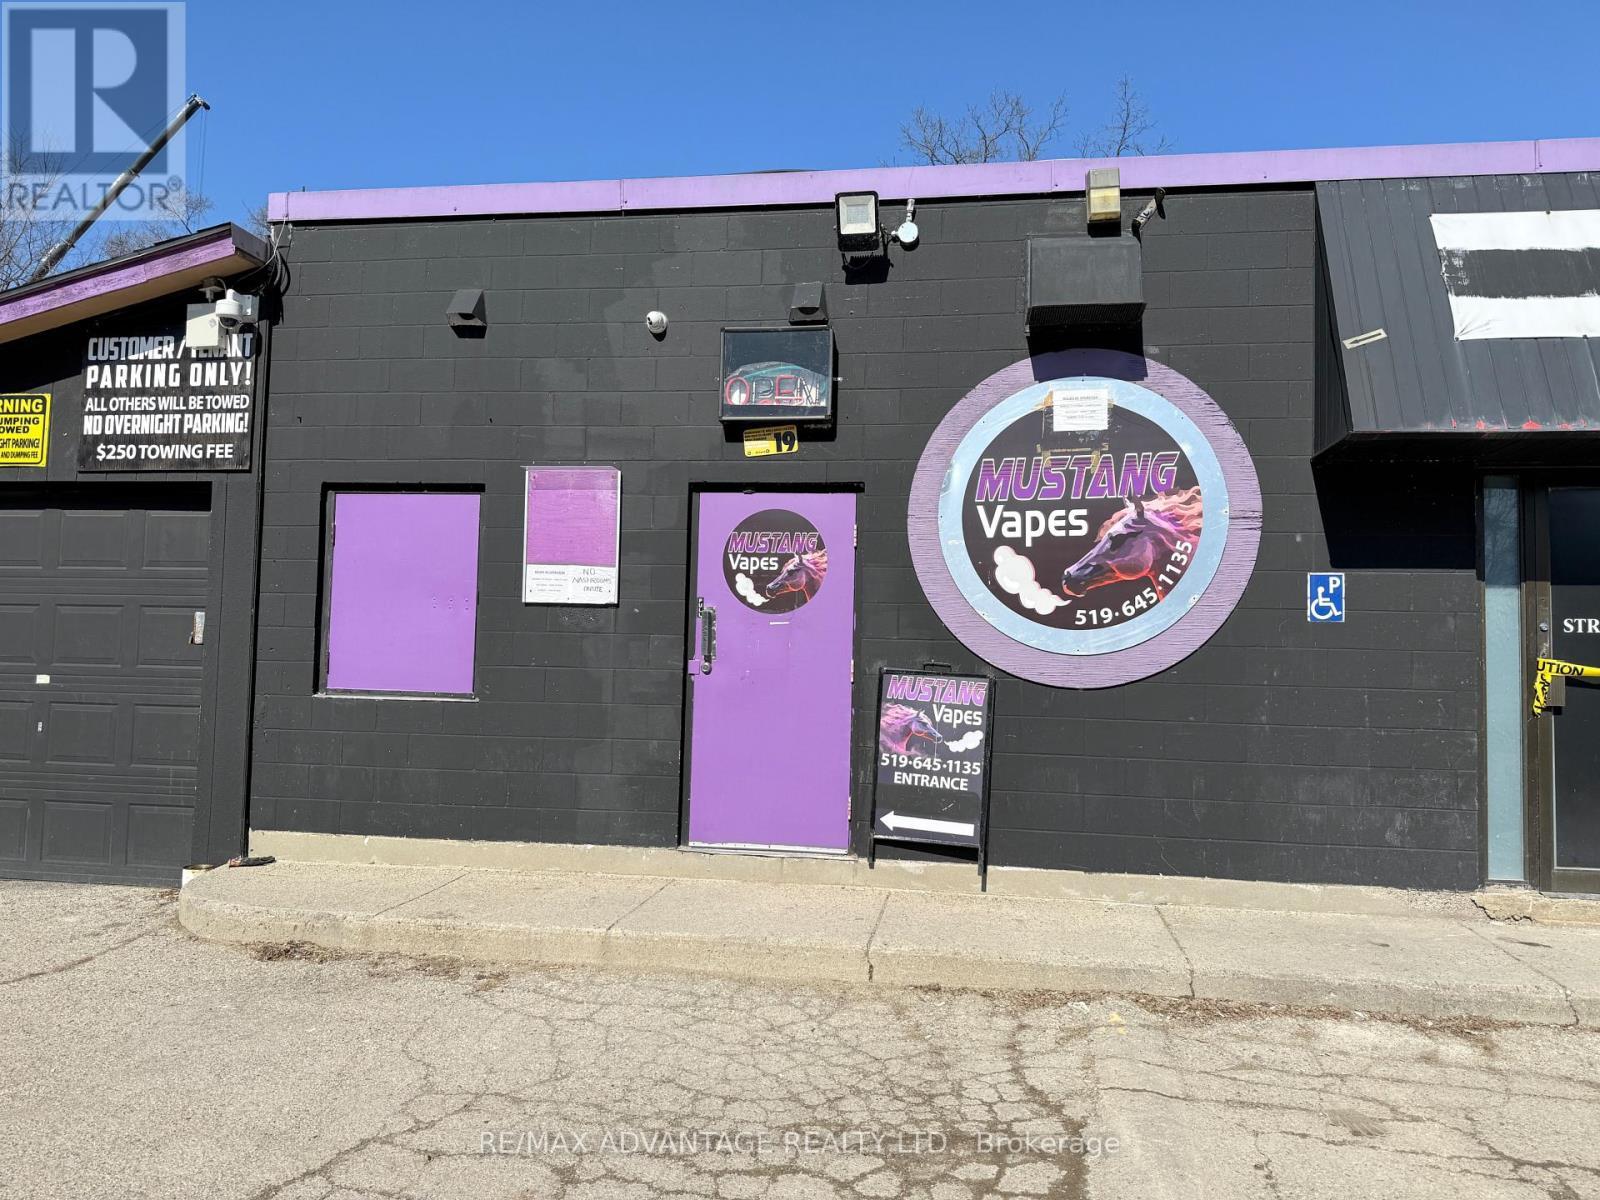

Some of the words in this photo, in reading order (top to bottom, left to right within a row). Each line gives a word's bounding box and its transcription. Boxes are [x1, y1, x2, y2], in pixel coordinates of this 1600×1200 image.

[88, 335, 175, 361] CUSTOMER
[86, 363, 181, 389] PARKING
[189, 361, 252, 387] ONLY!
[725, 374, 821, 406] OPEN
[85, 397, 107, 412] ALL
[109, 396, 156, 411] OTHERS
[158, 396, 186, 410] WILL
[188, 395, 203, 410] BE
[205, 394, 249, 409] TOWED
[83, 414, 102, 435] NO
[105, 413, 181, 435] OVERNIGHT
[183, 412, 249, 434] PARKING!
[96, 443, 136, 461] $250
[138, 443, 202, 459] TOWING
[206, 443, 234, 459] FEE
[774, 431, 796, 452] 19
[975, 451, 1180, 502] MUSTANG
[976, 505, 1088, 547] Vapes
[728, 532, 819, 553] MUSTANG
[728, 554, 779, 574] Vapes
[887, 675, 988, 706] MUSTANG
[932, 704, 983, 728] Vapes
[893, 772, 969, 791] ENTRANCE
